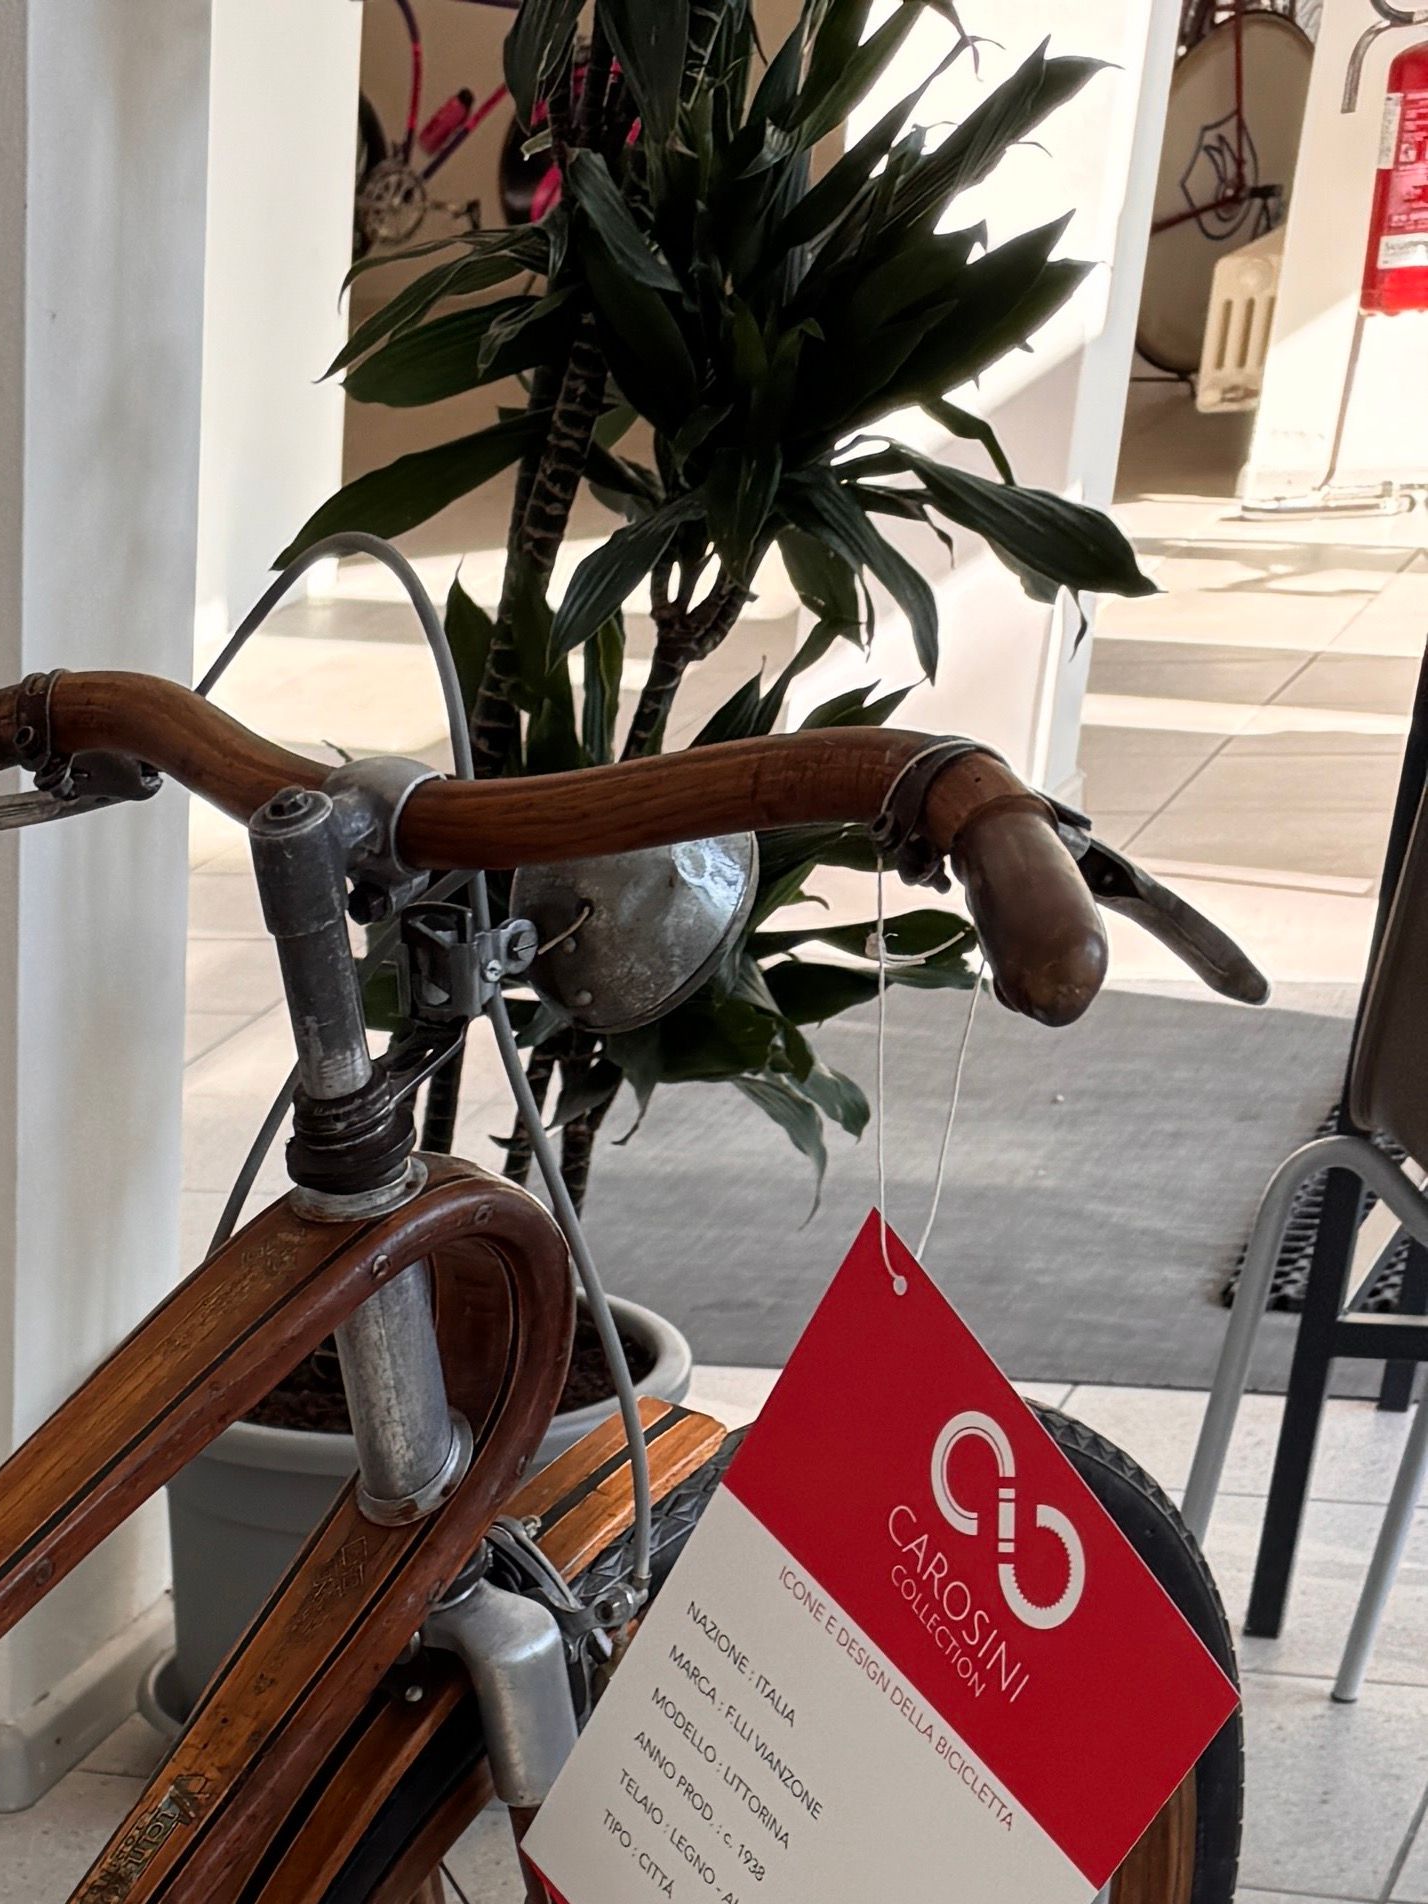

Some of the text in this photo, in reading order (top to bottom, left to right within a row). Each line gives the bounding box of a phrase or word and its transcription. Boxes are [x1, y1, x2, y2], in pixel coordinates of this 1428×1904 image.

[687, 1600, 750, 1675] NAZIONE
[755, 1673, 796, 1728] ITALIA
[888, 1505, 1030, 1703] CAROSINI
[891, 1565, 986, 1698] COLLECTION
[651, 1687, 718, 1764] MODELLO
[723, 1765, 790, 1850] LITTORINA
[669, 1645, 717, 1706] MARCA
[724, 1704, 753, 1743] F.LLI
[755, 1734, 824, 1821] VIANZONE
[779, 1566, 1015, 1832] ICONE E DESIGN DELLA BICICLETTA
[603, 1808, 633, 1849] TIPO
[619, 1768, 664, 1826] TELAIO
[670, 1825, 716, 1885] LEGNO
[634, 1731, 676, 1779] ANNO
[676, 1773, 715, 1827] PROD.
[737, 1843, 766, 1882] 1938
